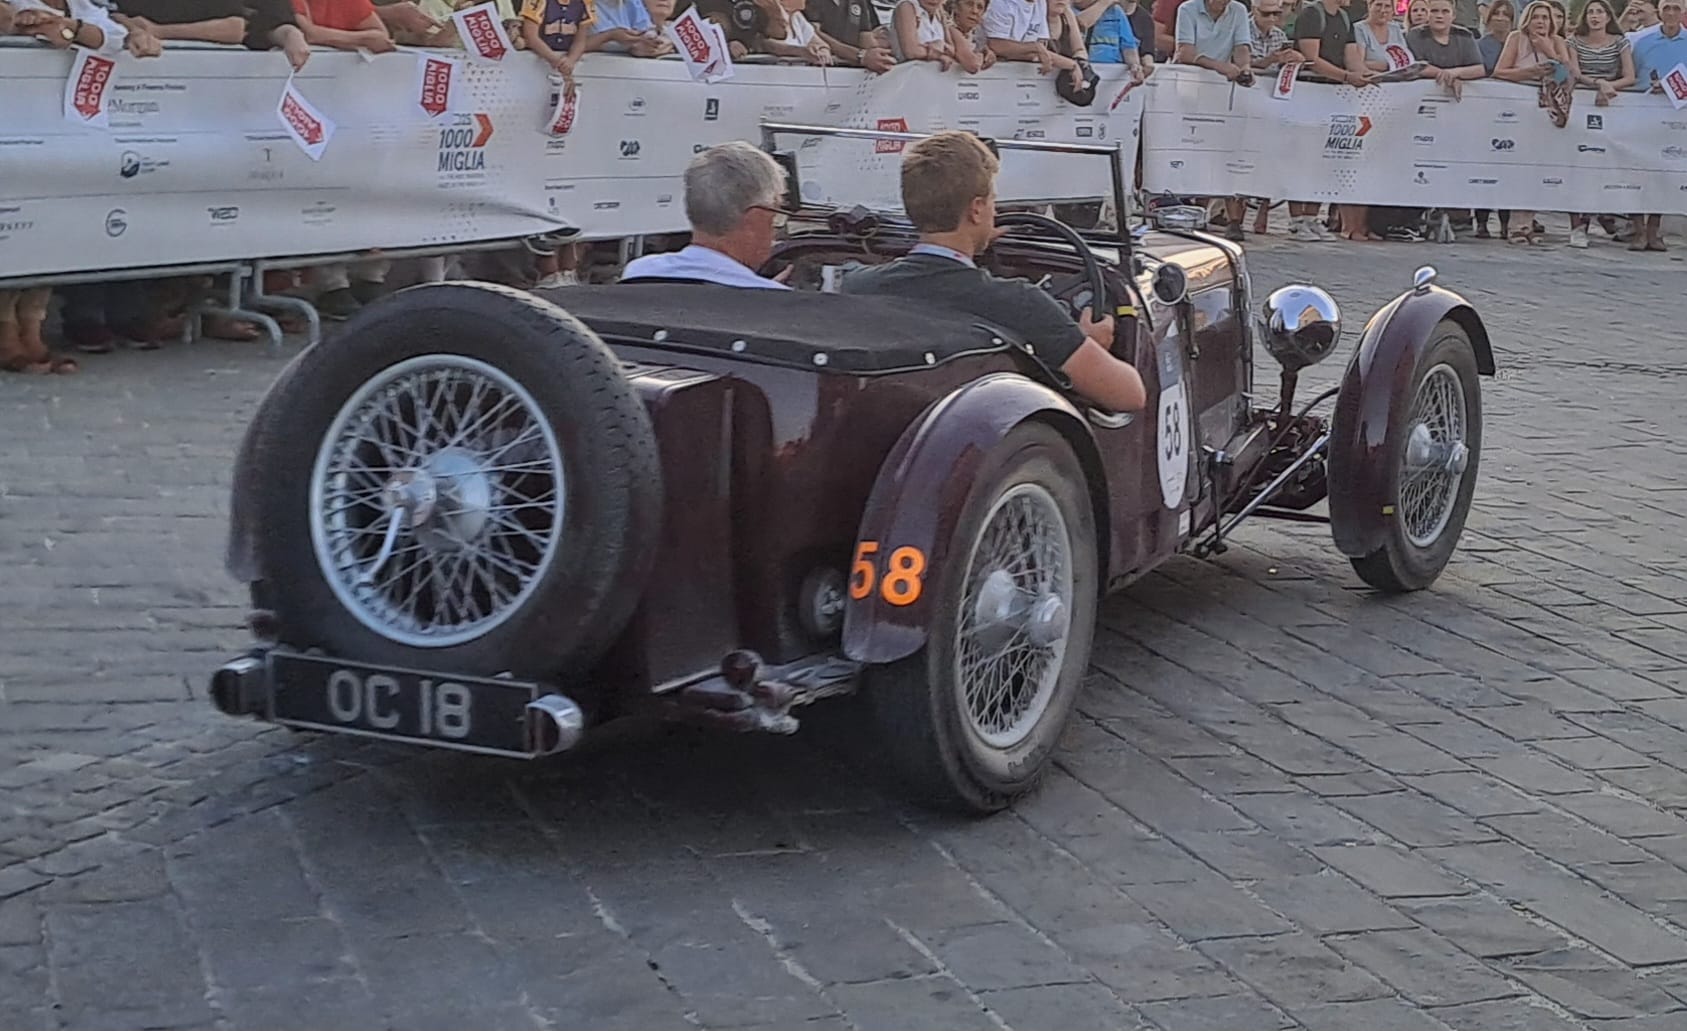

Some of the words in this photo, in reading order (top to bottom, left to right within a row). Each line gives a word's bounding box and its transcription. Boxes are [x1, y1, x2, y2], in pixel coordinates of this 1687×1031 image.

[465, 16, 491, 54] MIGLIA
[477, 15, 500, 49] 1000
[676, 26, 700, 59] MIGLIA
[685, 20, 705, 49] 1000
[88, 65, 110, 106] 1000
[423, 62, 438, 104] MIGLIA
[435, 68, 449, 104] 1000
[440, 129, 473, 148] 1000
[1325, 137, 1363, 150] MIGLIA
[1329, 124, 1356, 136] 1000
[438, 151, 485, 171] MIGLIA
[1165, 402, 1181, 461] 58
[850, 541, 926, 605] 58
[328, 669, 399, 730] OC
[420, 680, 473, 738] 18
